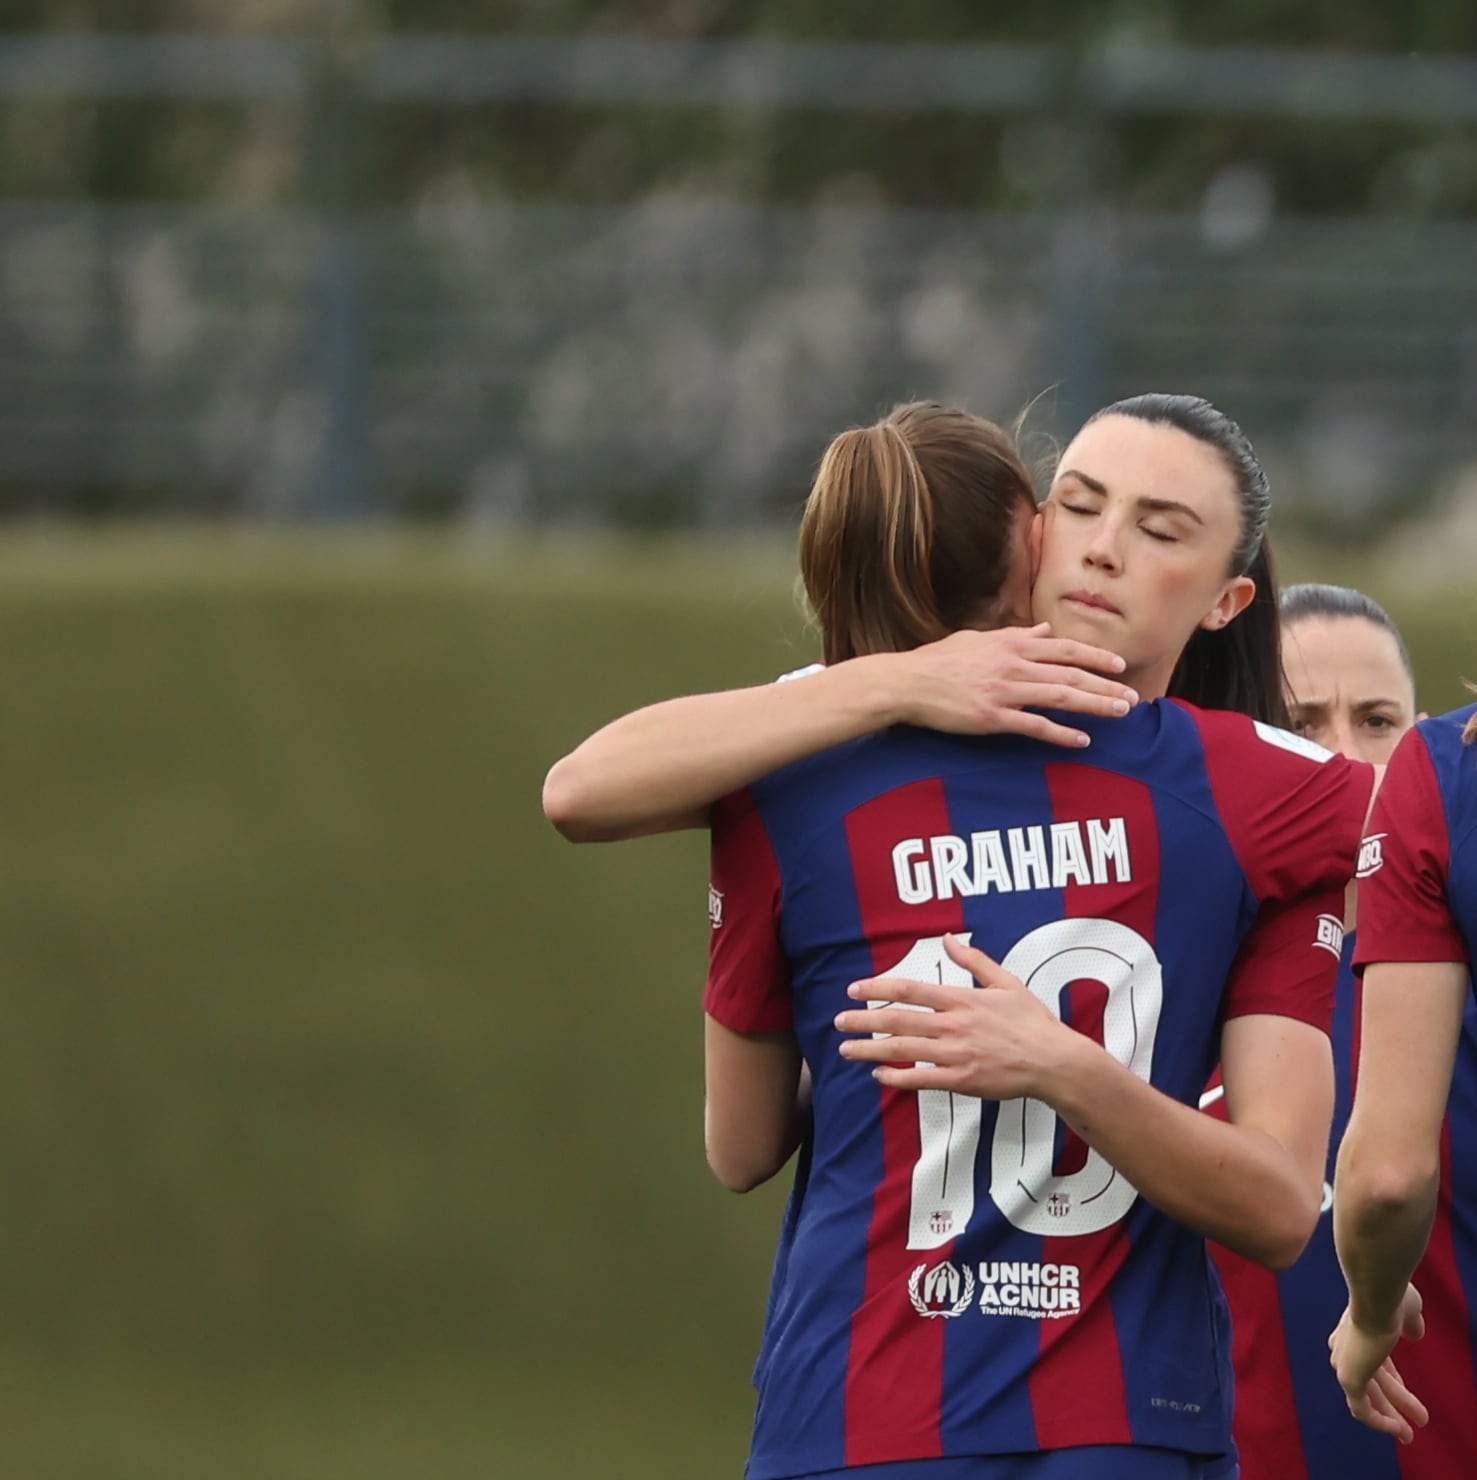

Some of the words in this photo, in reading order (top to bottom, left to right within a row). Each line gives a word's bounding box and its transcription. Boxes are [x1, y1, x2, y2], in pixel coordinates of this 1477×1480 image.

[891, 816, 1132, 905] GRAHAM
[866, 917, 1163, 1250] 10
[979, 1262, 1079, 1288] UNHCR
[979, 1285, 1080, 1309] ACNUR
[981, 1306, 997, 1315] The
[999, 1307, 1012, 1316] UN
[1014, 1308, 1046, 1319] Refugee
